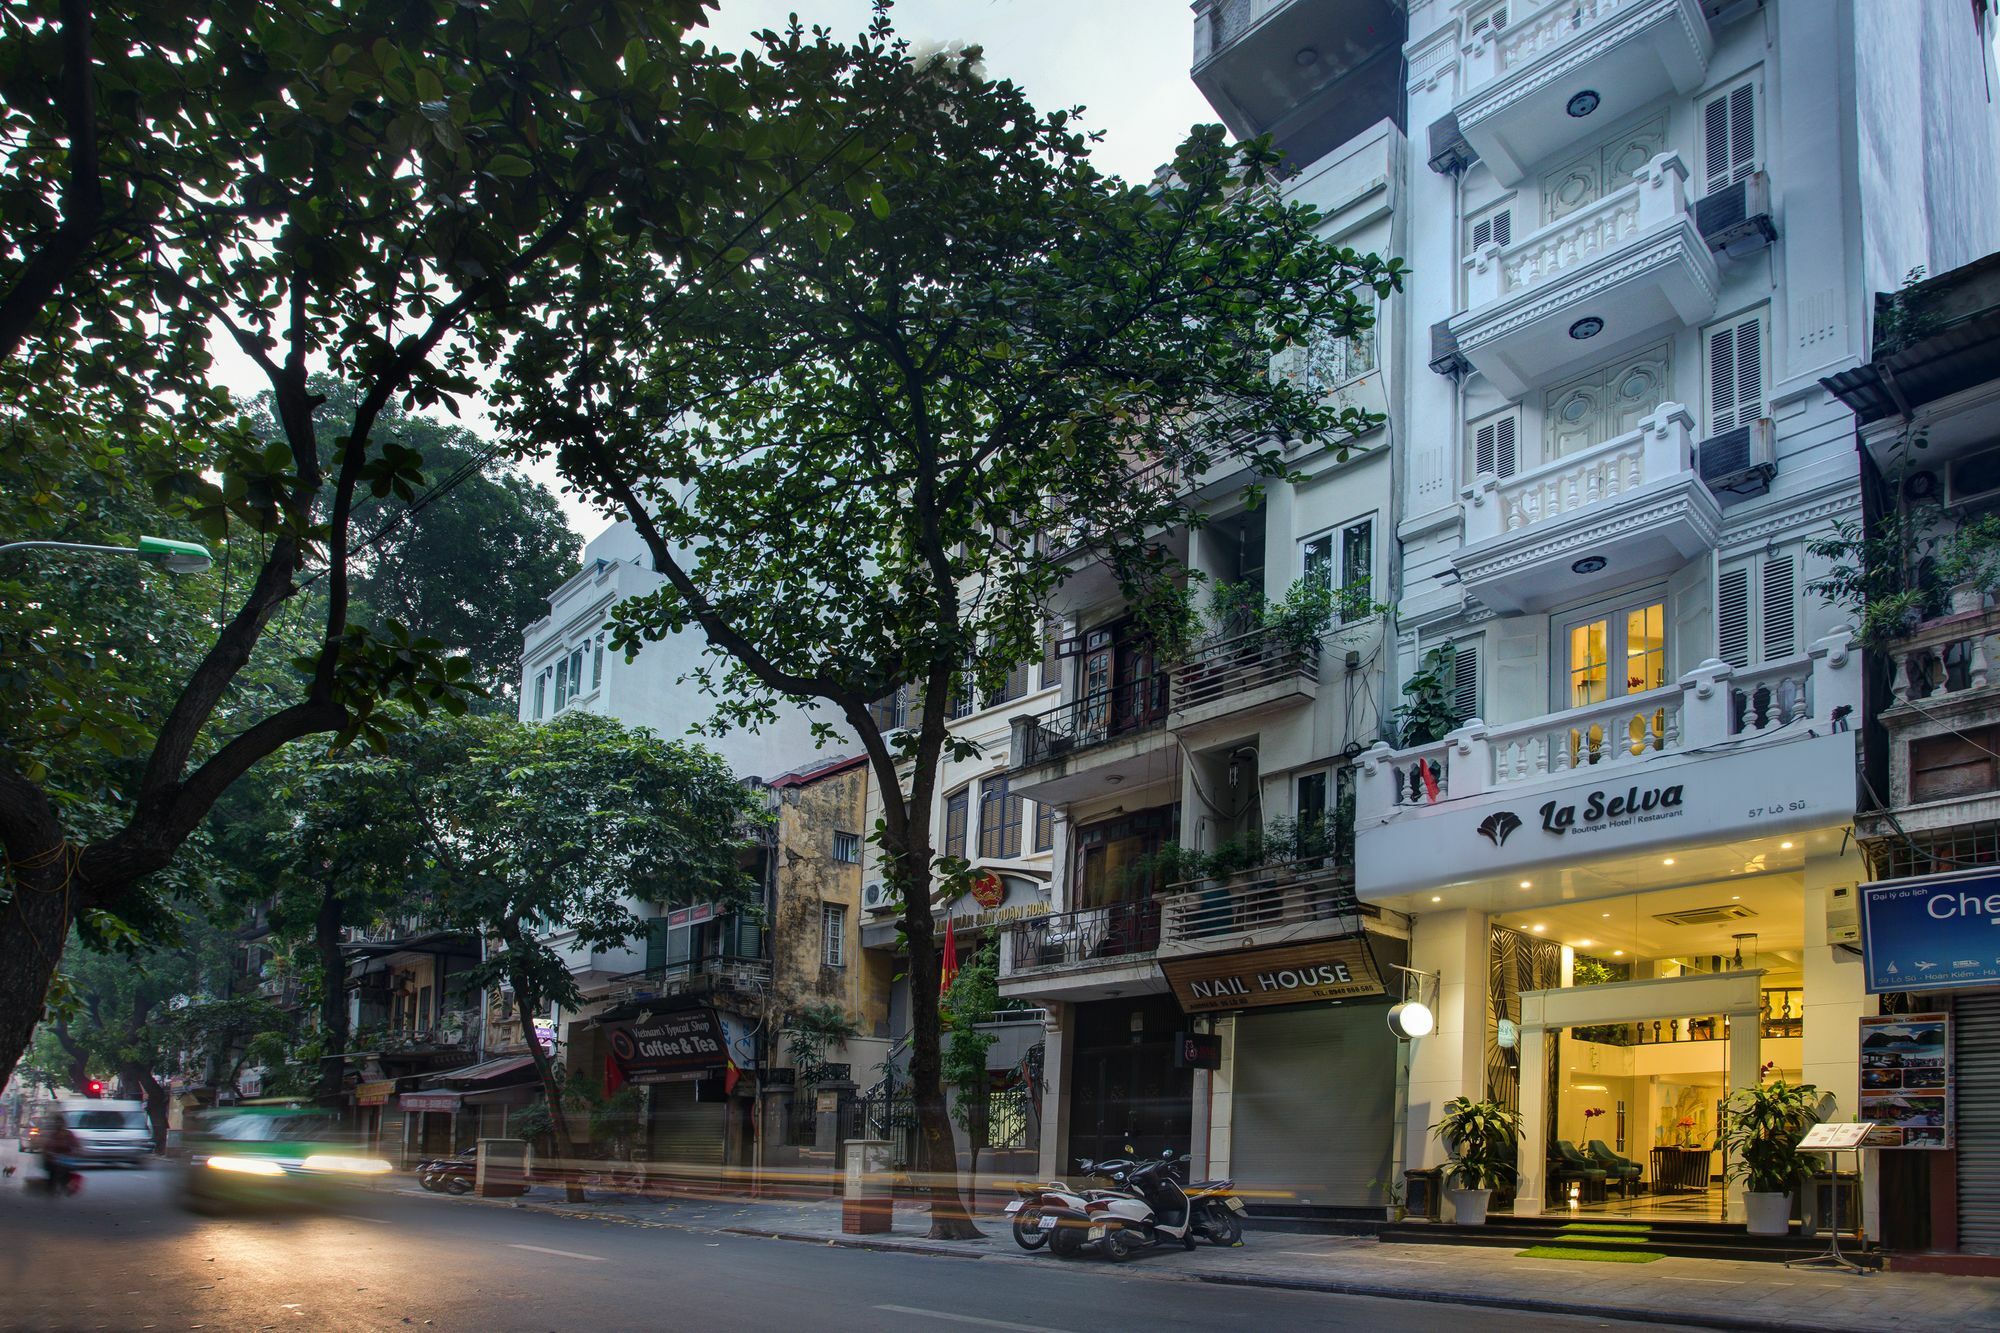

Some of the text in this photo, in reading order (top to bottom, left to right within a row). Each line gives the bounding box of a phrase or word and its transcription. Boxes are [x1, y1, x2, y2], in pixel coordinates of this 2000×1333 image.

[1539, 784, 1683, 835] La Selva
[1748, 799, 1805, 818] 57 Lò Sũ
[1571, 810, 1683, 835] Boutique Hotel Restaurant
[1872, 893, 1888, 901] Đại
[1899, 890, 1910, 898] du
[1927, 892, 2000, 919] Che
[1190, 965, 1352, 999] NAIL HOUSE
[632, 1021, 710, 1038] Vietnam's Typical Shop
[639, 1036, 719, 1057] Coffee & Tea
